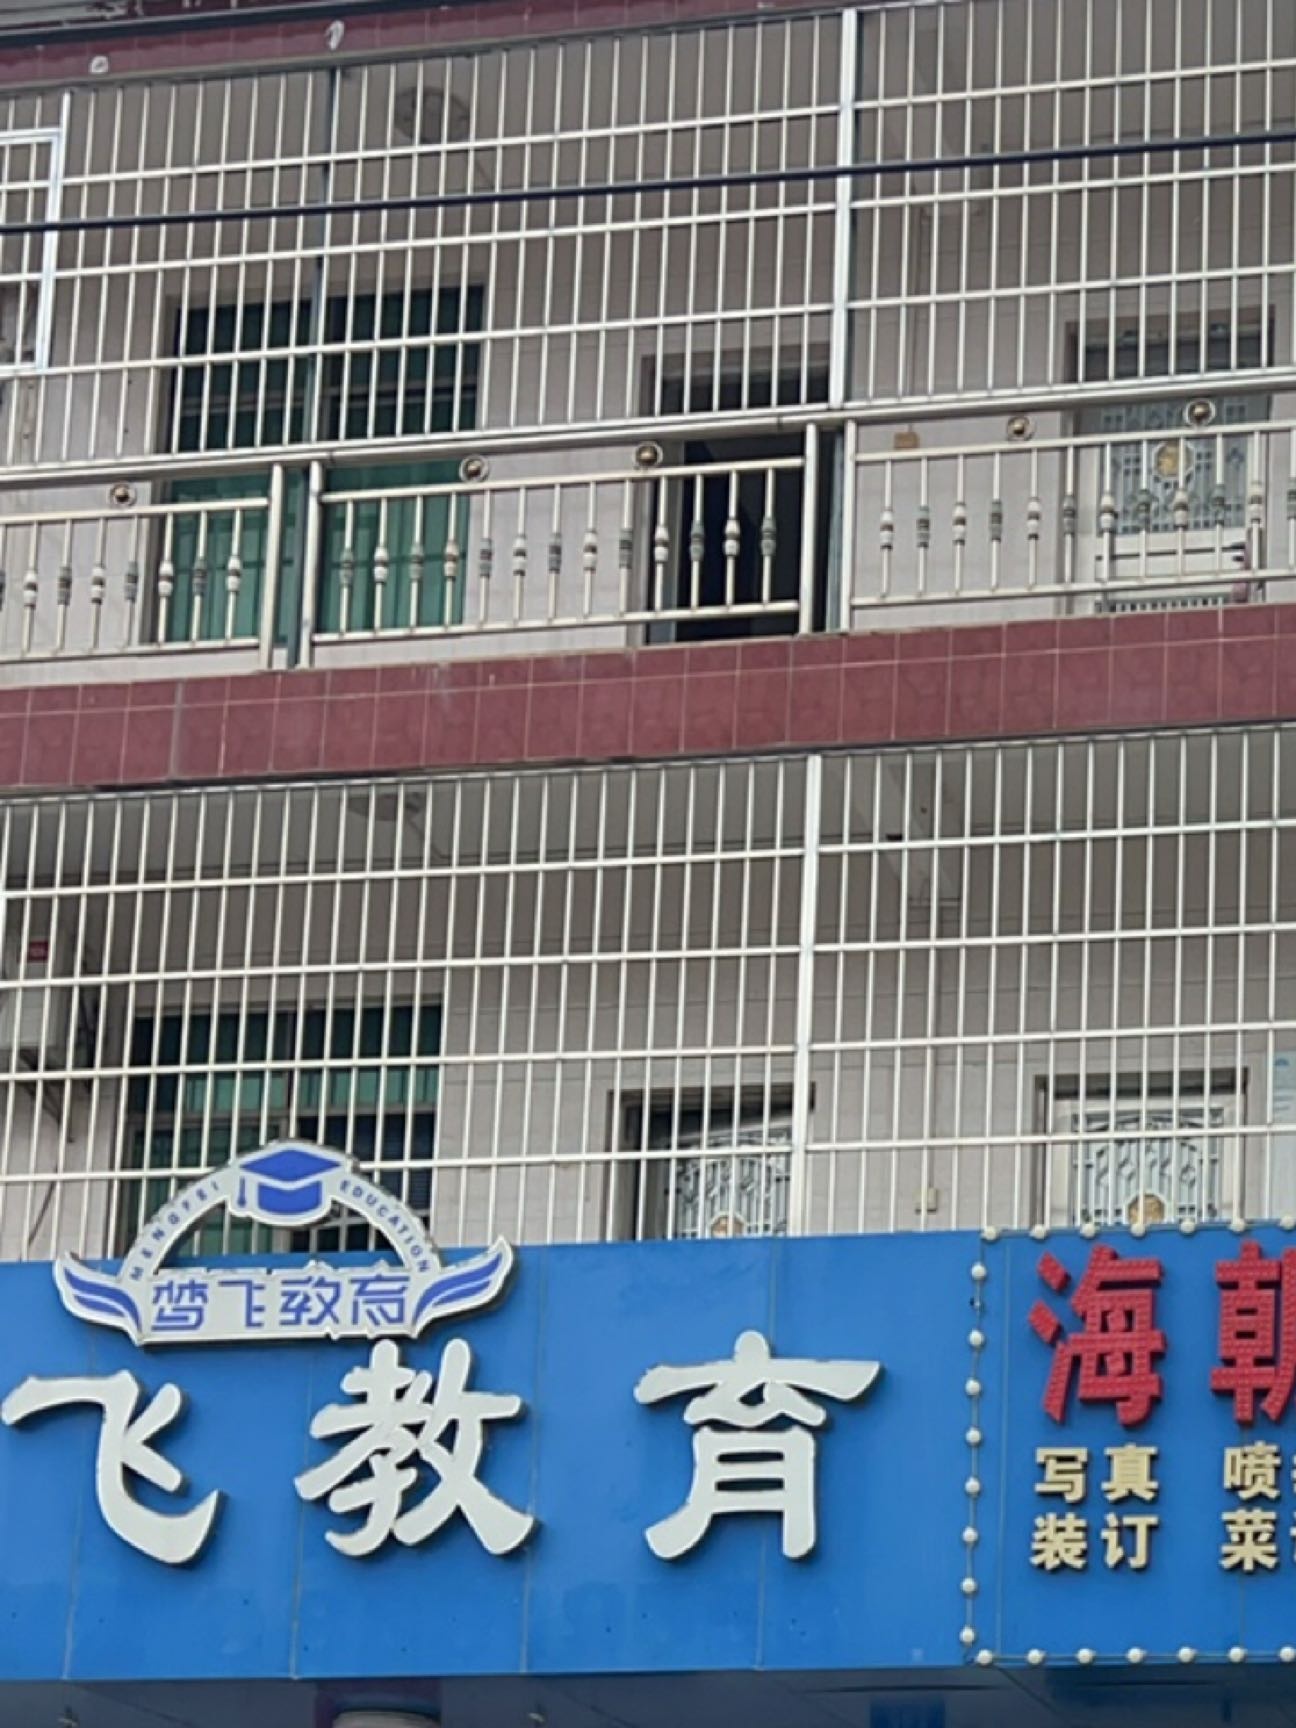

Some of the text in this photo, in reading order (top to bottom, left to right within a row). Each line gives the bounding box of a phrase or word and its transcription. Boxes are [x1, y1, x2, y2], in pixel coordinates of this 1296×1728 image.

[338, 1178, 432, 1275] EDUCATION
[152, 1274, 410, 1331] 梦飞教育
[1, 1331, 882, 1565] 飞教育
[1036, 1445, 1159, 1503] 写真
[1032, 1513, 1159, 1571] 装订
